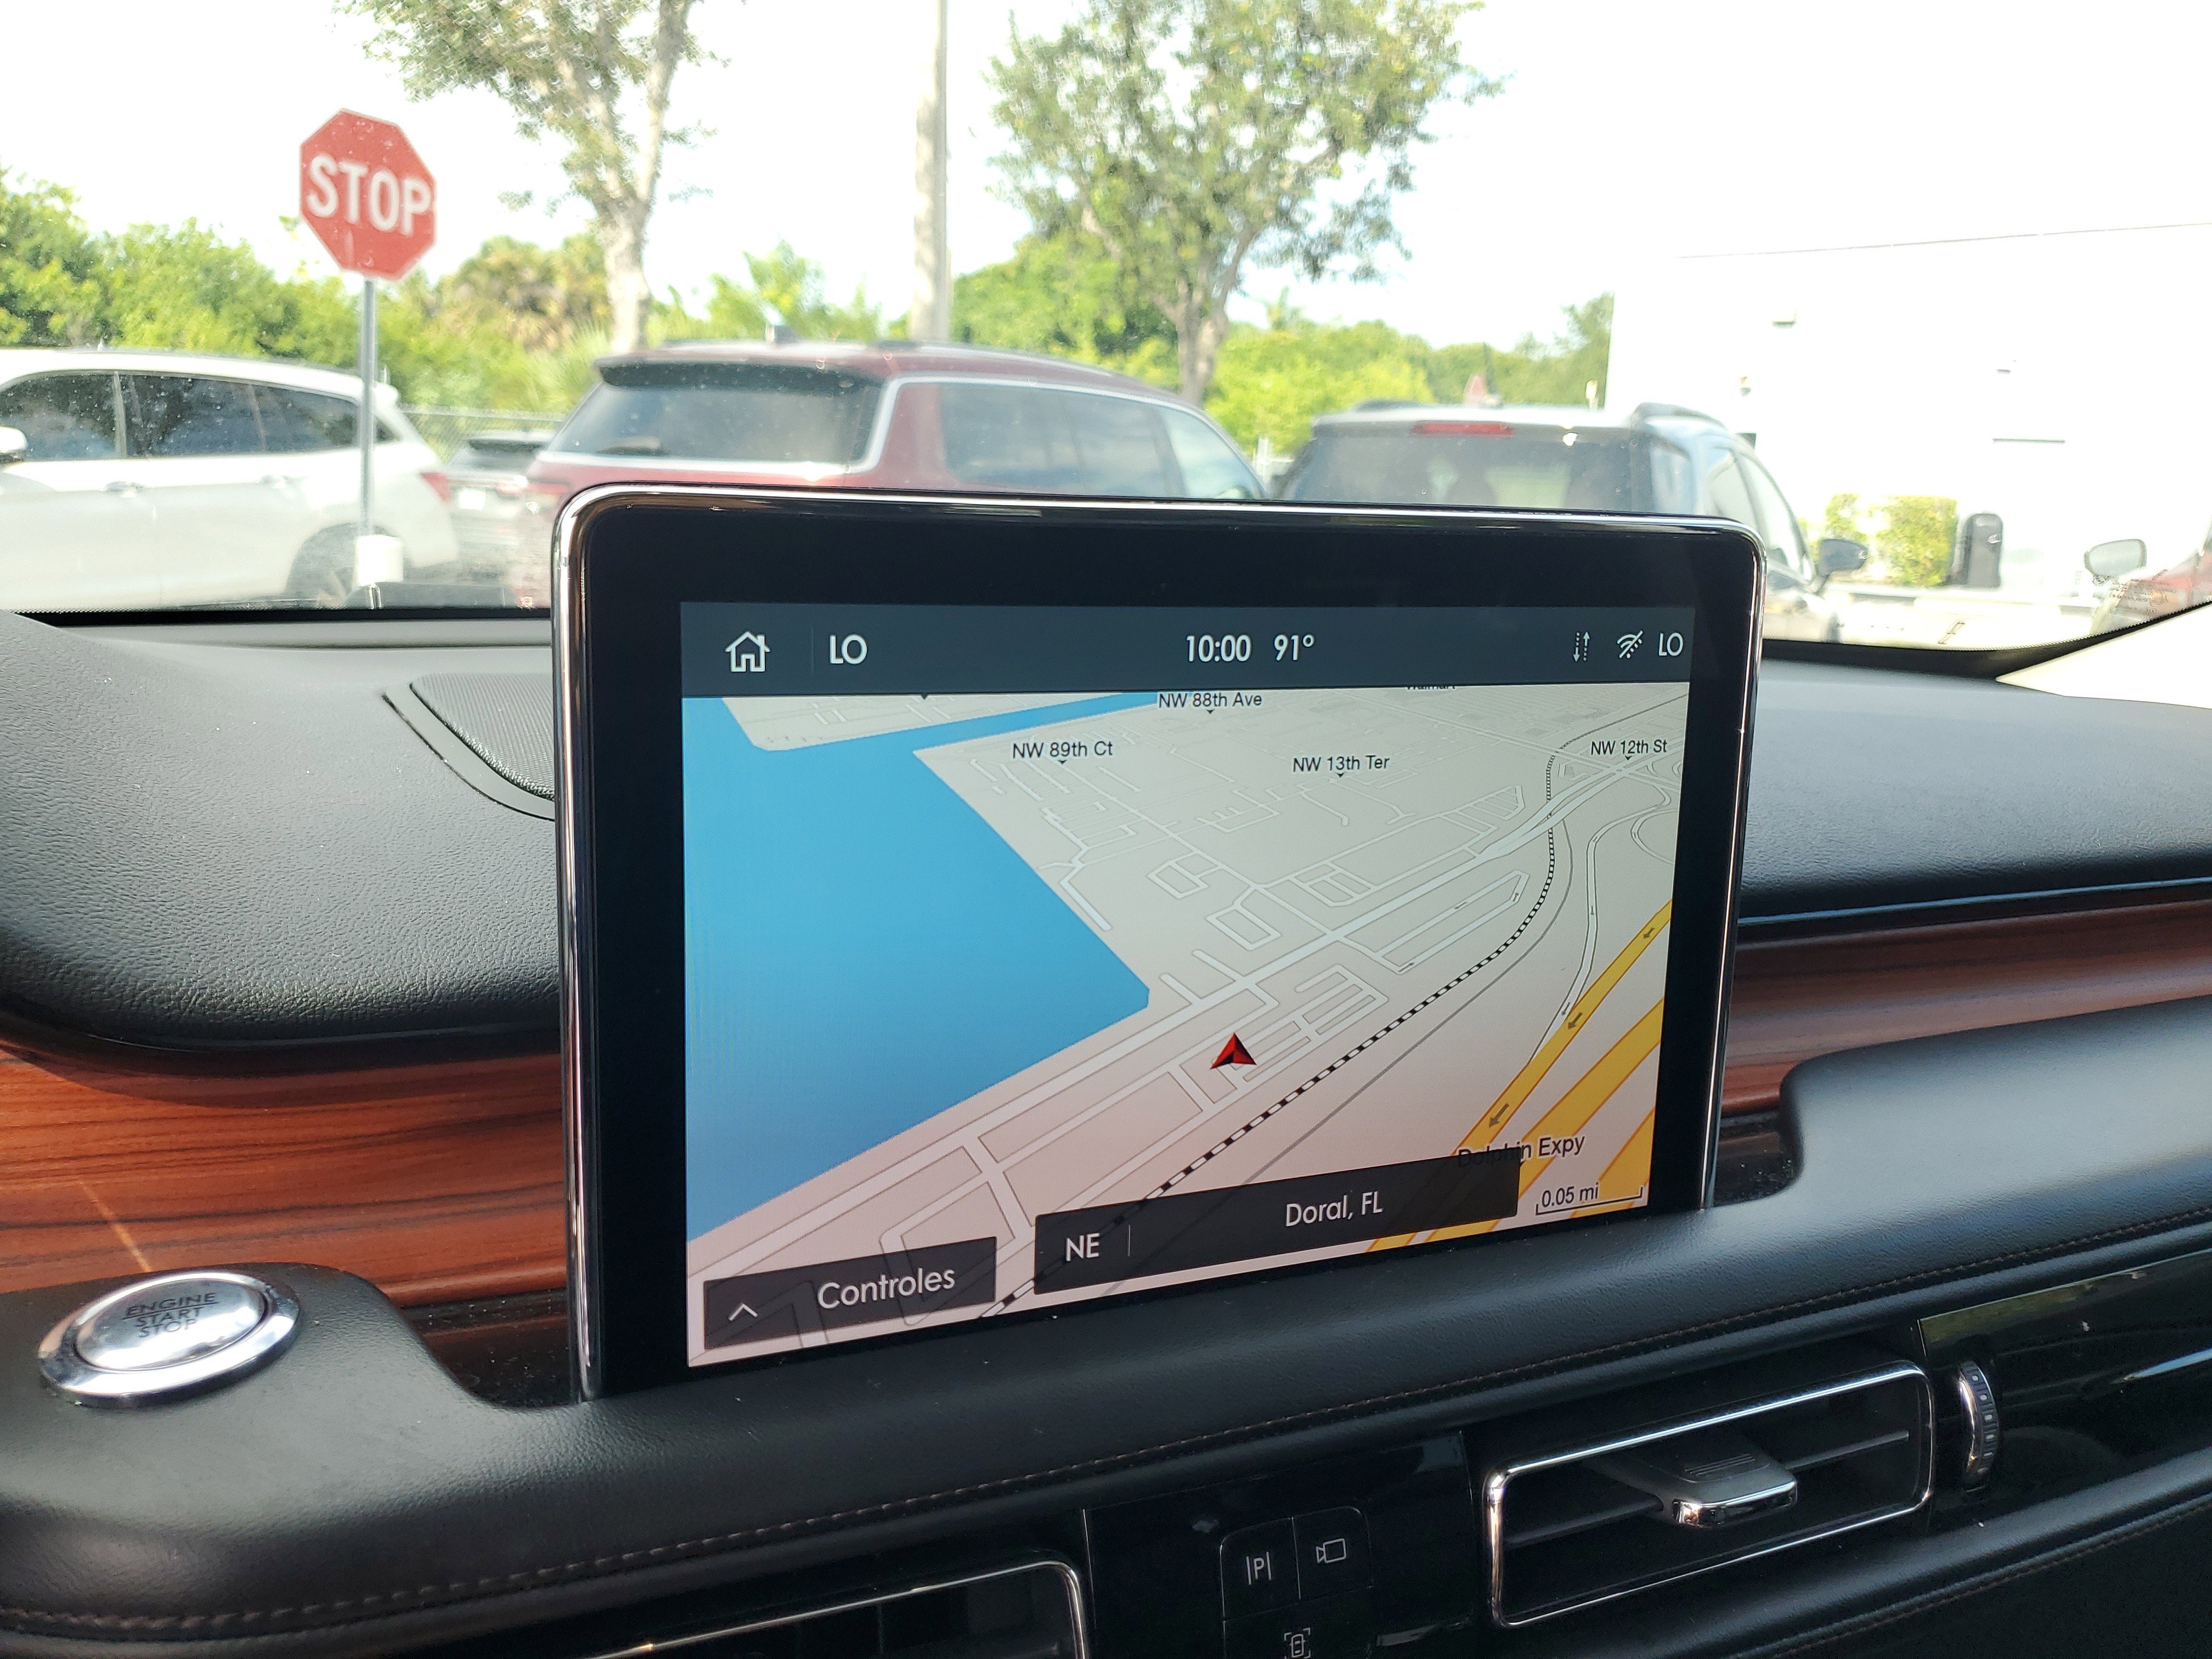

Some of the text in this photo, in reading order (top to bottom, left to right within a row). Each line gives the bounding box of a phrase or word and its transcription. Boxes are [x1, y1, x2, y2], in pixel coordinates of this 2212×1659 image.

[306, 152, 431, 236] STOP
[829, 634, 868, 664] LO
[1186, 634, 1251, 662] 10:00
[1658, 632, 1684, 657] LO
[1159, 692, 1262, 708] NW 88th Ave
[1013, 741, 1113, 759] NW 89th Ct
[1590, 739, 1668, 755] NW 12th St
[1293, 755, 1390, 772] NW 13th Ter
[1538, 1136, 1585, 1158] Expy
[1542, 1182, 1599, 1207] 0.05 mi
[1285, 1191, 1383, 1227] Doral, FL
[1065, 1233, 1100, 1261] NE
[817, 1268, 956, 1310] Controles
[126, 1292, 217, 1316] ENGINE
[134, 1307, 205, 1327] START
[139, 1318, 197, 1338] STOP
